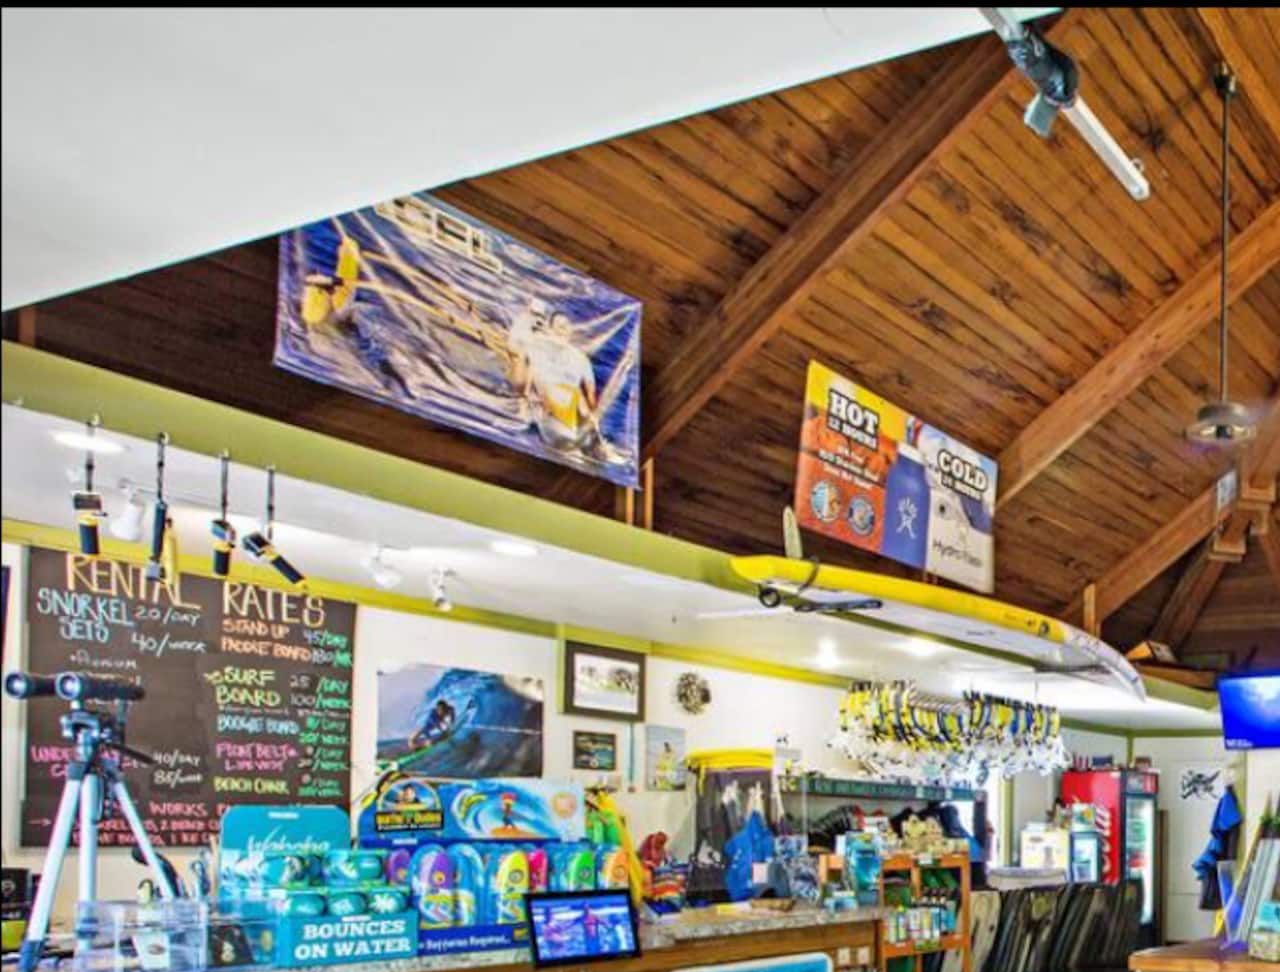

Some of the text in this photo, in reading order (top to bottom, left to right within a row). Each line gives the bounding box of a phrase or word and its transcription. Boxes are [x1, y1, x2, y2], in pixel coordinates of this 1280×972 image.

[829, 390, 879, 435] HOT
[939, 450, 987, 492] COLD
[66, 552, 326, 629] RENTAL RATES
[37, 587, 135, 627] SNORKEL
[59, 616, 110, 643] SETS
[222, 619, 269, 636] STAND
[271, 624, 290, 639] UP
[223, 666, 276, 686] SURF
[216, 685, 281, 706] BOARD
[150, 802, 208, 817] WORKS
[303, 920, 406, 939] BOUNCES
[294, 938, 412, 960] ON WATER
